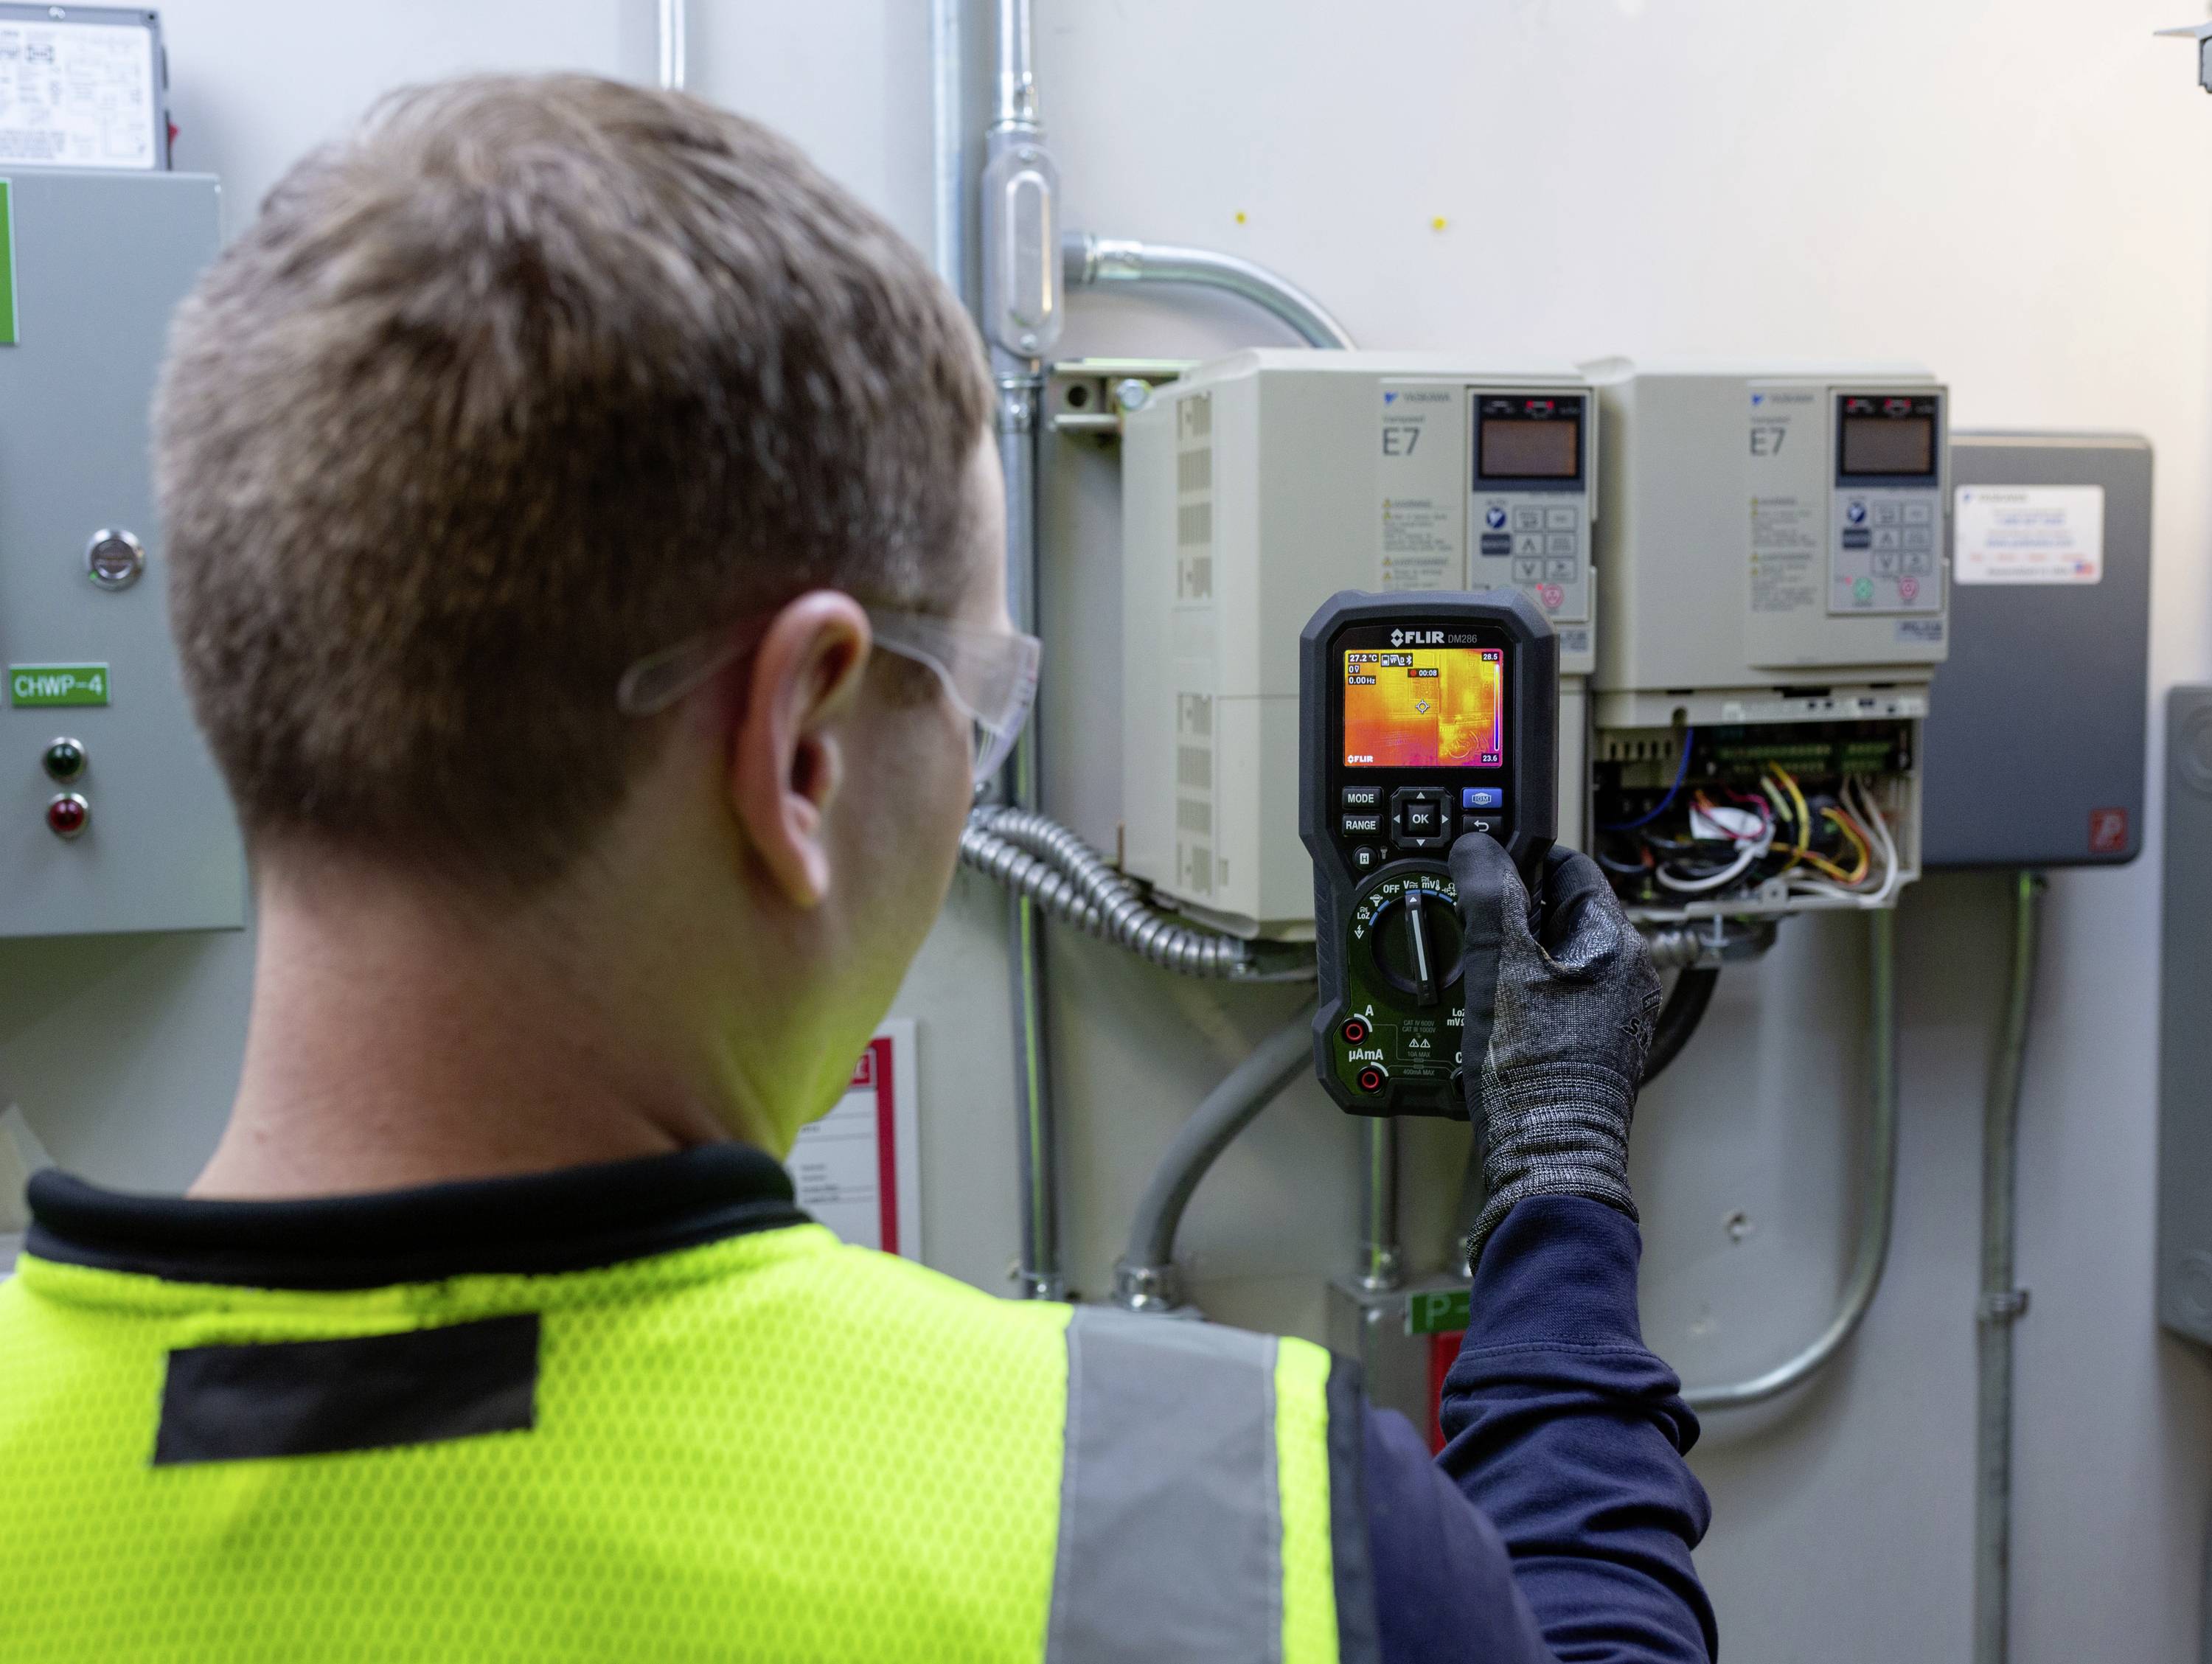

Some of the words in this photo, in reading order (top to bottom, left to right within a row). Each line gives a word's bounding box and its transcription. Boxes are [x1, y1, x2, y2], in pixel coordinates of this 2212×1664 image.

[1383, 427, 1420, 456] E7
[1750, 428, 1785, 456] E7
[1405, 631, 1445, 644] FLIR
[1447, 634, 1478, 644] DM286
[15, 674, 102, 697] CHWP-4
[1354, 755, 1374, 763] FLIR
[1348, 793, 1374, 804] MODE
[1412, 814, 1429, 824] OK
[1346, 820, 1377, 830] RANGE
[1382, 884, 1400, 894] OFF
[1357, 912, 1371, 920] LoZ
[1365, 1004, 1374, 1016] A
